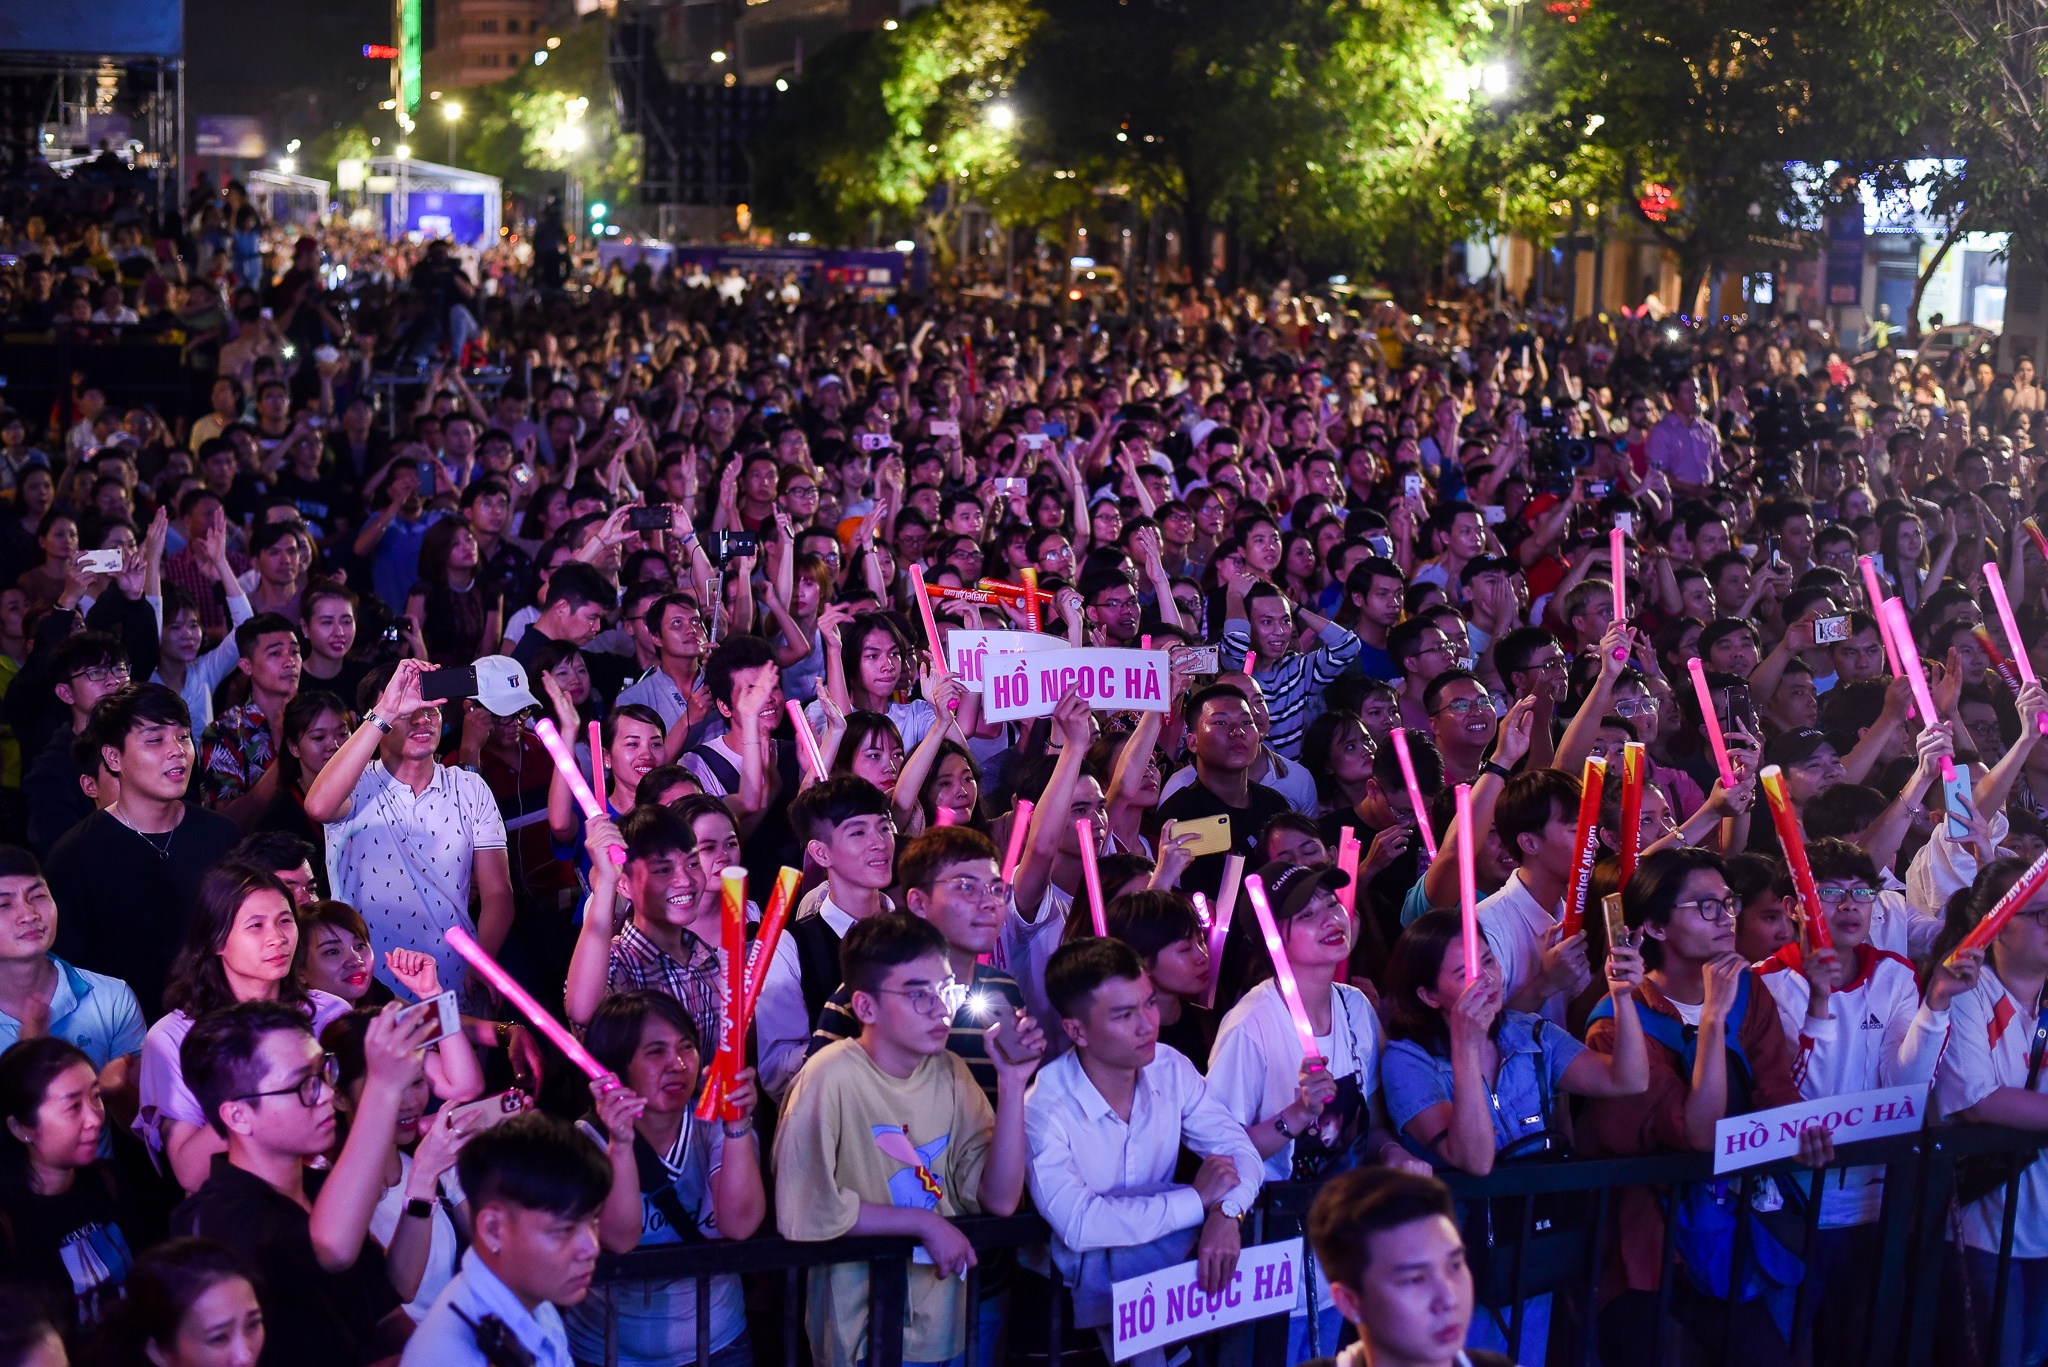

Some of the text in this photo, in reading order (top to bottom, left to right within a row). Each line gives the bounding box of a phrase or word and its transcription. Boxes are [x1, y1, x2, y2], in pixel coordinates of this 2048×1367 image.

[994, 660, 1029, 709] HỒ
[1125, 661, 1161, 700] HÀ
[1724, 1120, 1769, 1155] HỒ
[1872, 1096, 1916, 1122] HÀ
[1119, 1281, 1156, 1342] HỒ
[1253, 1252, 1294, 1301] HÀ
